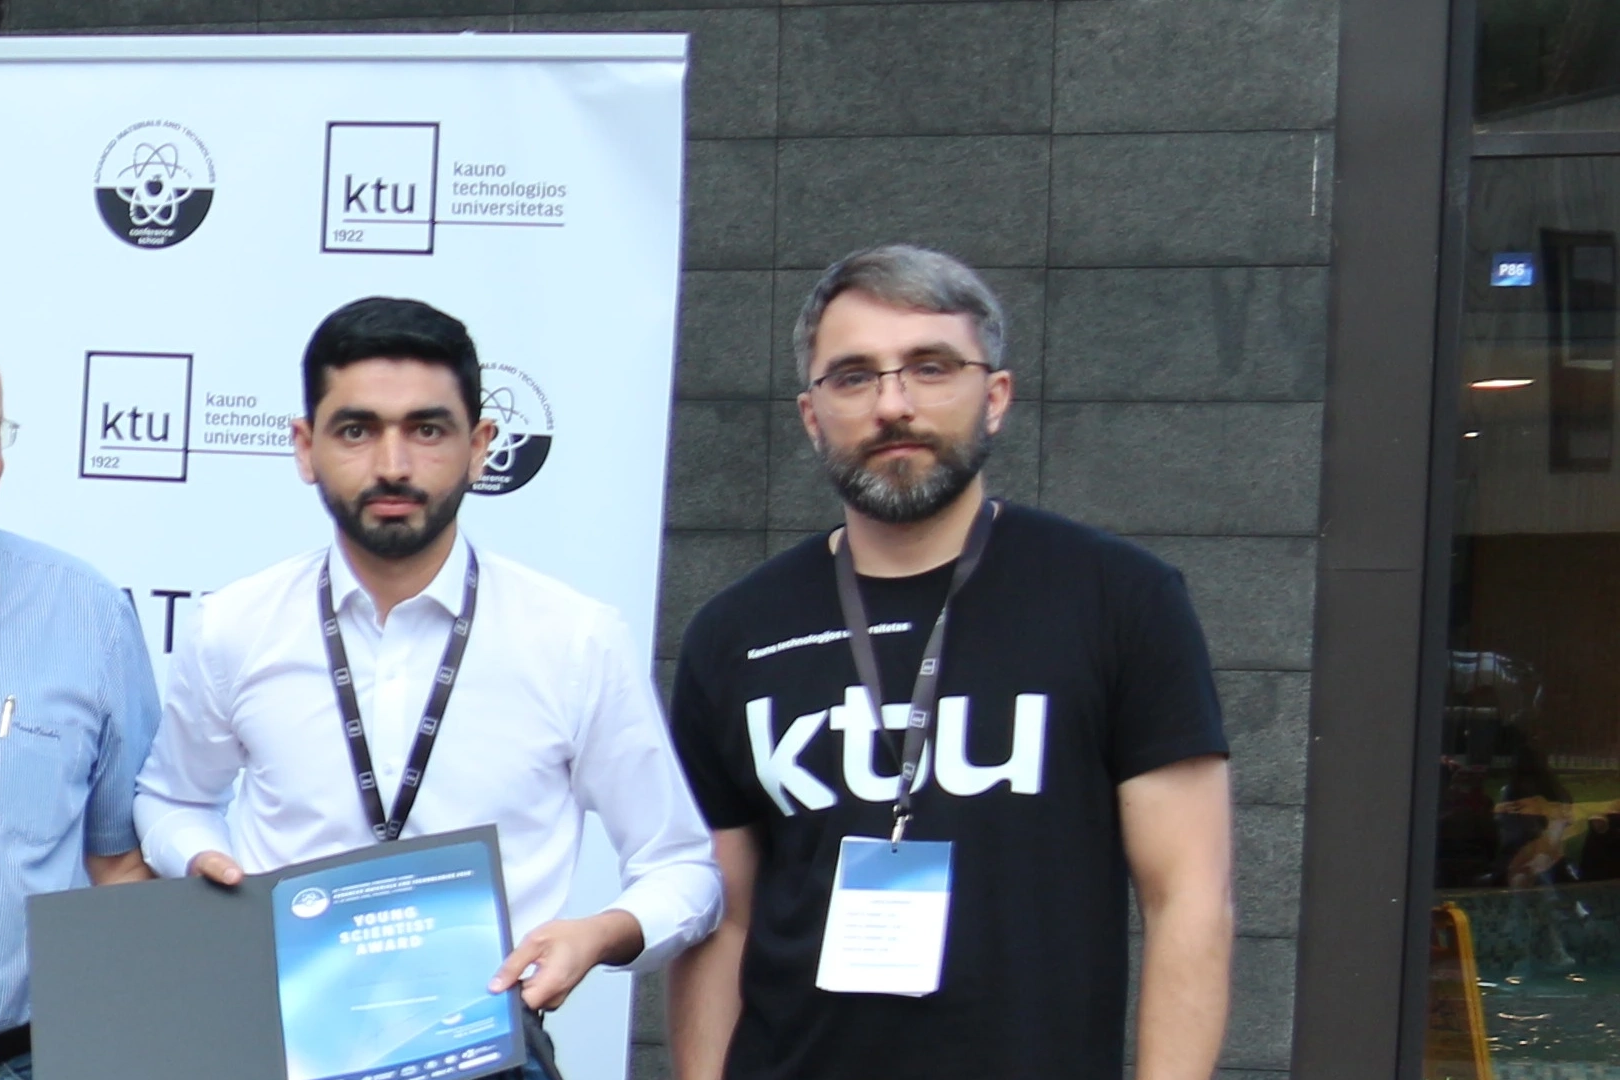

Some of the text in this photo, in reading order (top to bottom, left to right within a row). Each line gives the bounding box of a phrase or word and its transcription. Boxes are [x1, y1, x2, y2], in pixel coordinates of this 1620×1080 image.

[452, 161, 506, 177] kauno
[343, 173, 416, 214] ktu
[452, 181, 567, 200] technologijos
[451, 200, 564, 217] universitetas
[332, 229, 365, 242] 1922
[1499, 263, 1525, 276] P86
[205, 392, 257, 408] kauno
[99, 402, 170, 442] ktu
[204, 412, 296, 430] technologi
[90, 456, 120, 469] 1922
[746, 684, 1048, 818] ktu
[353, 906, 419, 928] YOUNG
[339, 917, 436, 945] SCIENTIST
[356, 935, 423, 956] AWARD
